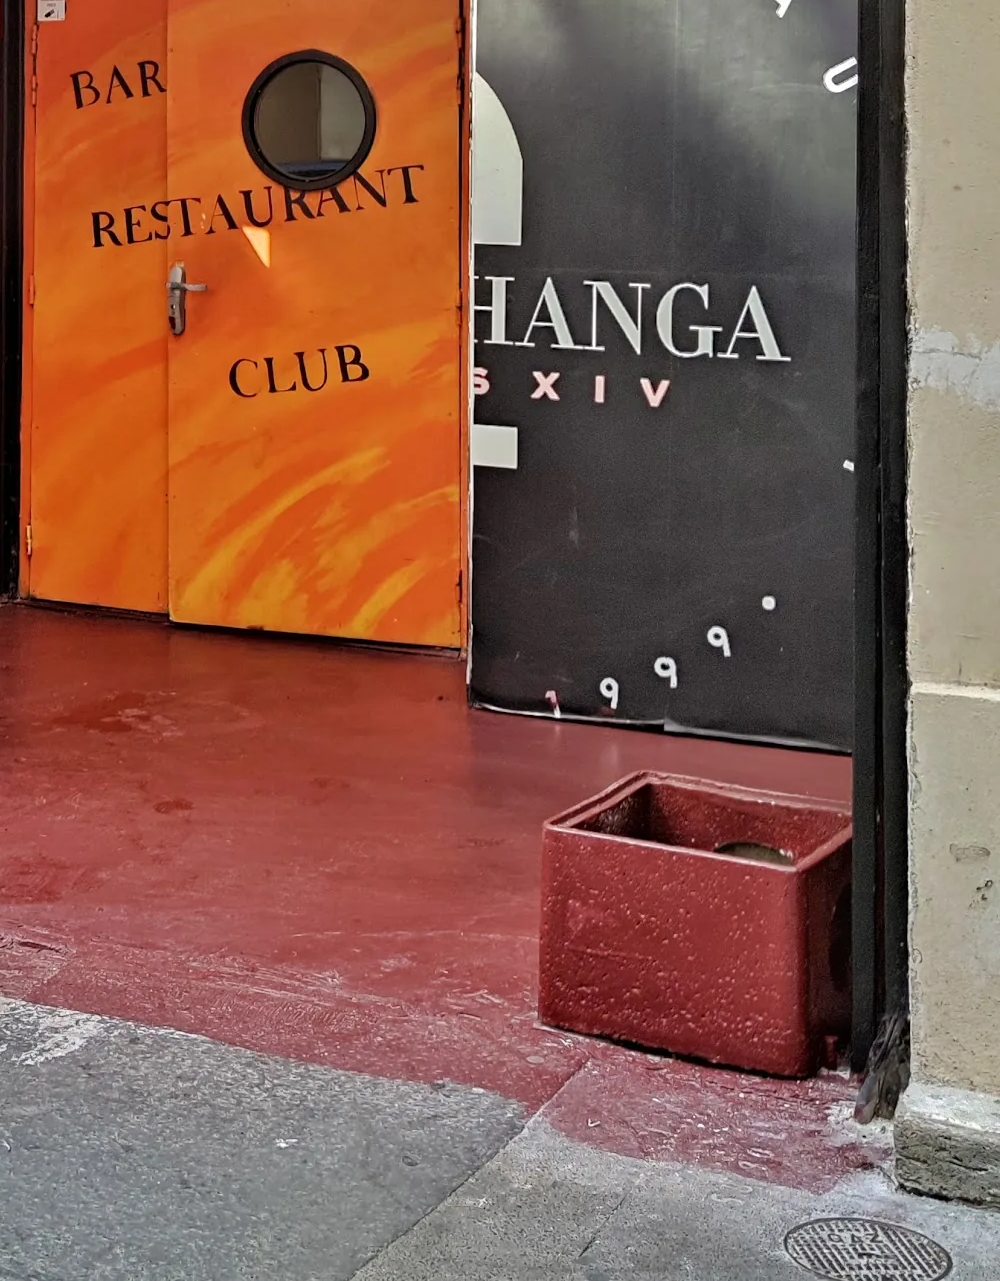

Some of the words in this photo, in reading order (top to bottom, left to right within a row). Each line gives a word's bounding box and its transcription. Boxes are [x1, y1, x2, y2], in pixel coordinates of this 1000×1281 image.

[70, 60, 167, 109] BAR
[91, 163, 424, 248] RESTAURANT
[473, 276, 791, 362] HANGA
[228, 344, 370, 398] CLUB
